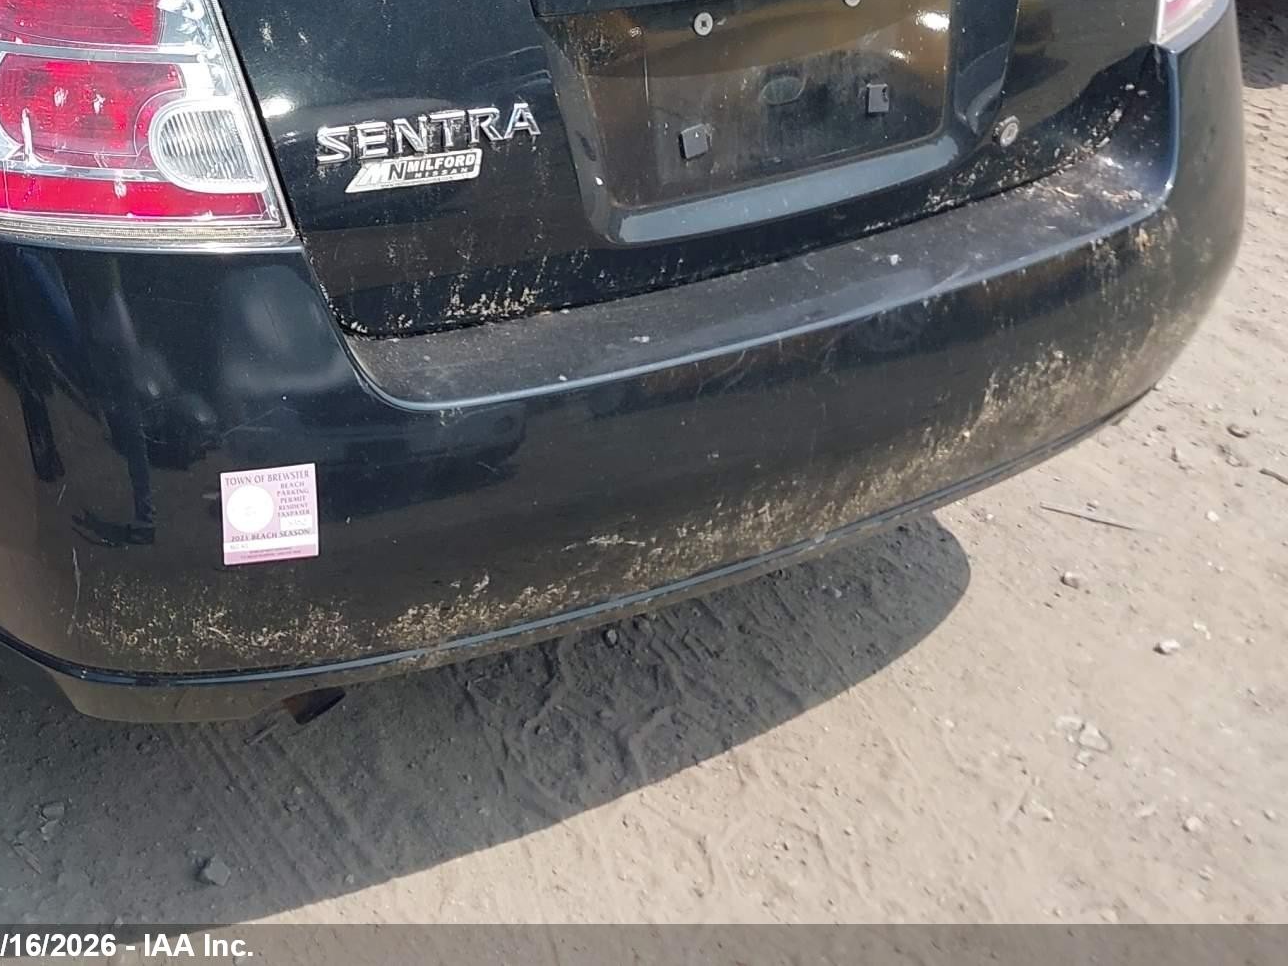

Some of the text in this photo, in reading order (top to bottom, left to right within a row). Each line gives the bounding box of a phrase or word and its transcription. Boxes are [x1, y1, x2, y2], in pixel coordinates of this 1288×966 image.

[315, 102, 542, 164] SENTRA
[406, 153, 476, 173] MILFORD
[414, 166, 469, 179] NISSAN
[225, 470, 309, 486] TOWN OF BREWSTER
[280, 481, 305, 489] BEACH
[276, 488, 310, 497] PARKING
[280, 496, 307, 504] PERMIT
[252, 531, 278, 540] BEACH
[279, 528, 311, 538] SEASON
